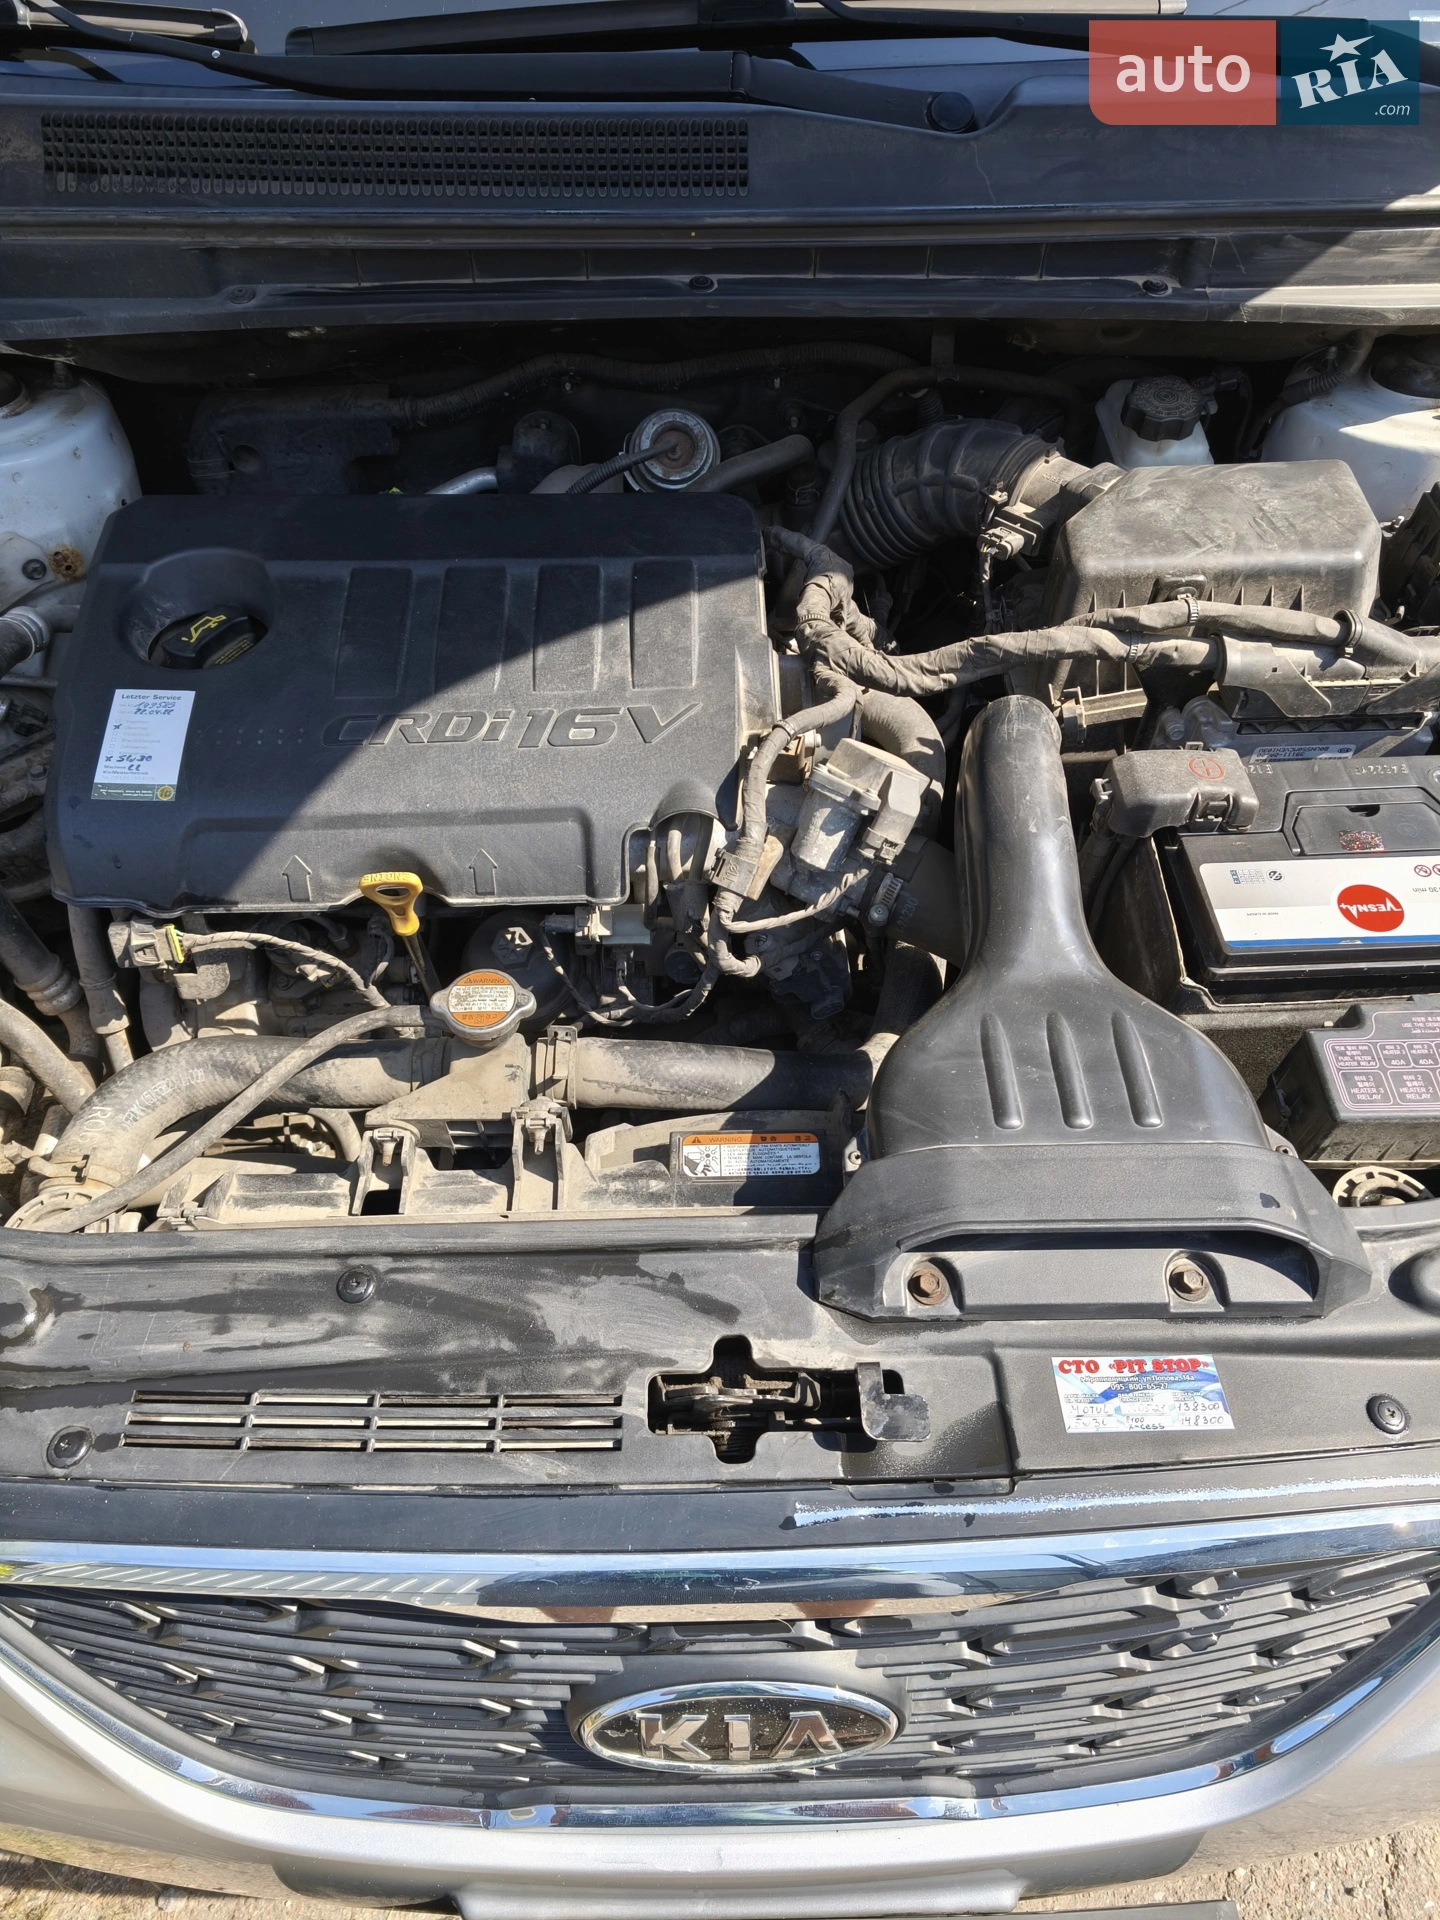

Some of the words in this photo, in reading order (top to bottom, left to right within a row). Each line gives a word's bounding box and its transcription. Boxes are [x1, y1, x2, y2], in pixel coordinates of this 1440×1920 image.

[322, 709, 515, 747] CRDi
[518, 702, 703, 749] 16V
[1058, 1360, 1100, 1374] СТО
[1176, 1402, 1220, 1412] 138300
[635, 1711, 843, 1760] KIA
